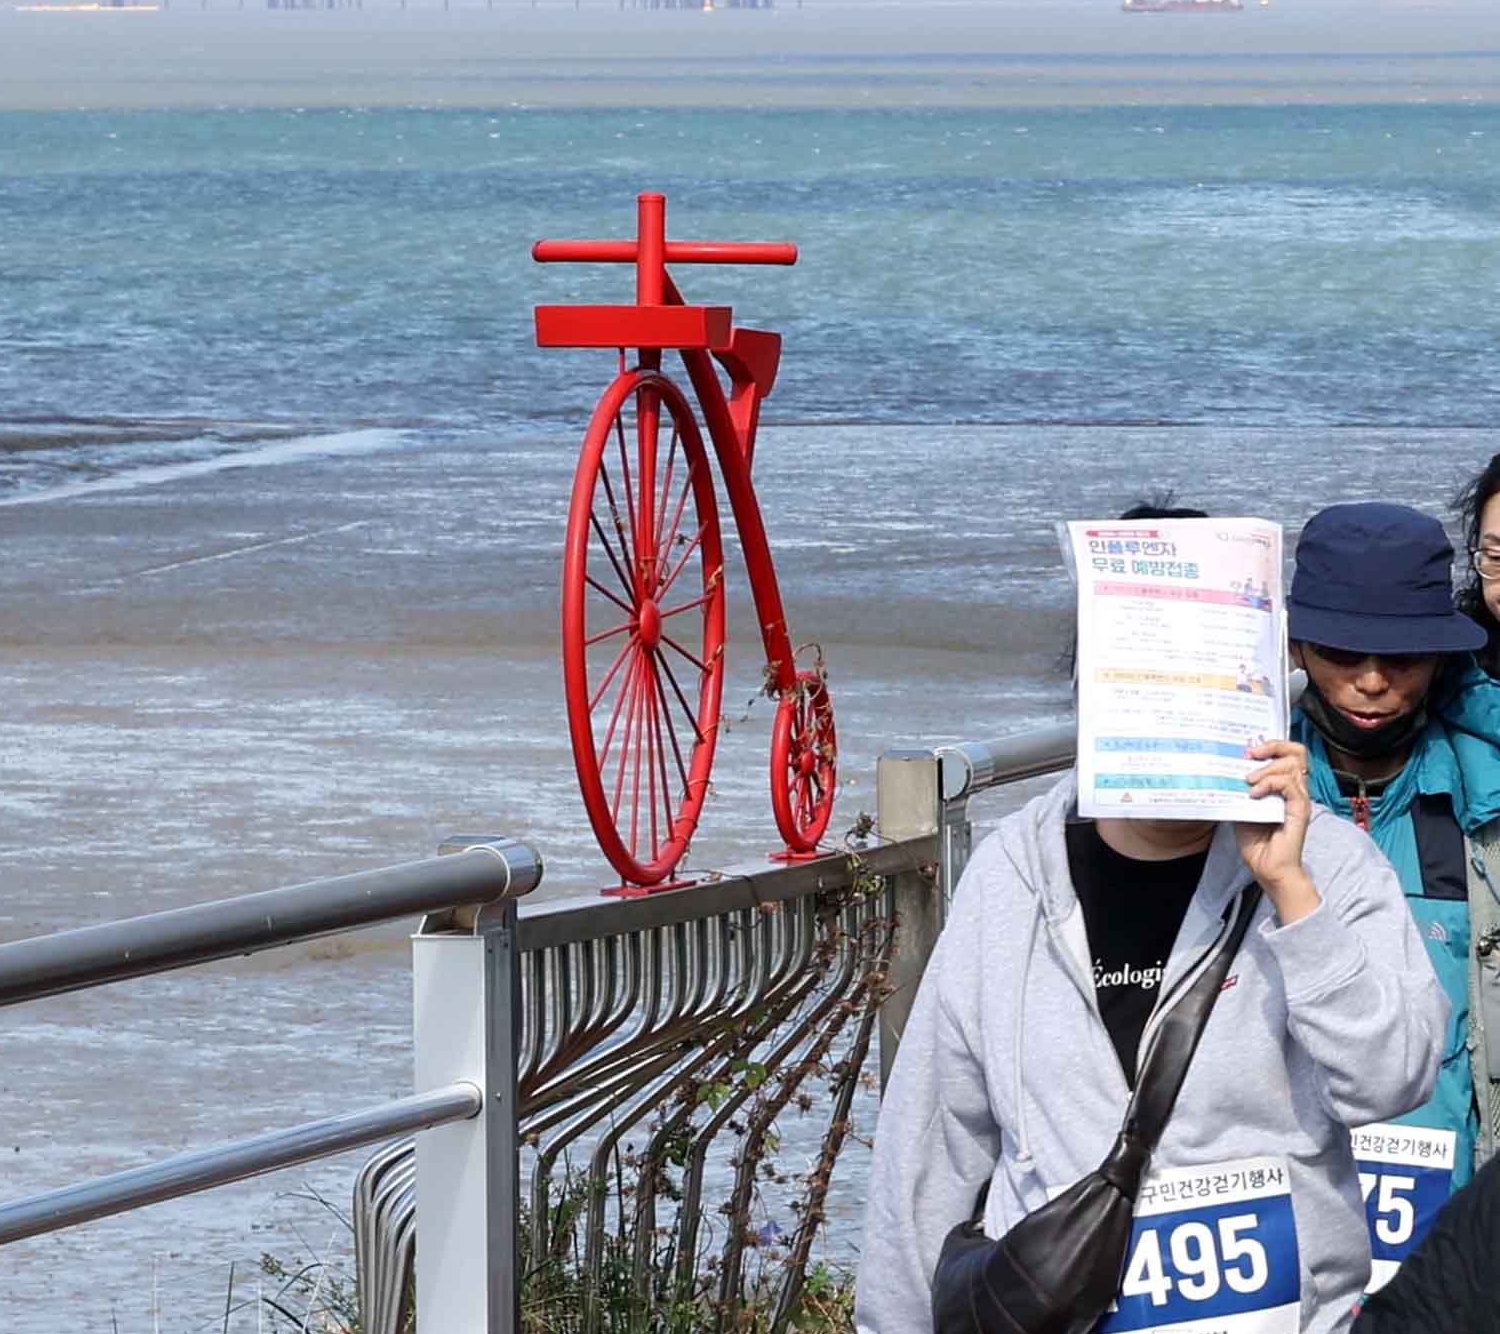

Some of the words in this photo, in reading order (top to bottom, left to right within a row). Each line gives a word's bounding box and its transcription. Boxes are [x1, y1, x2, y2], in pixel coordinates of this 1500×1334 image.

[1088, 540, 1177, 557] 인플루엔자
[1091, 557, 1127, 574] 무료
[1132, 558, 1200, 579] 예방접종
[1139, 1167, 1285, 1206] 구민건강걷기행사
[1104, 1212, 1269, 1314] 495
